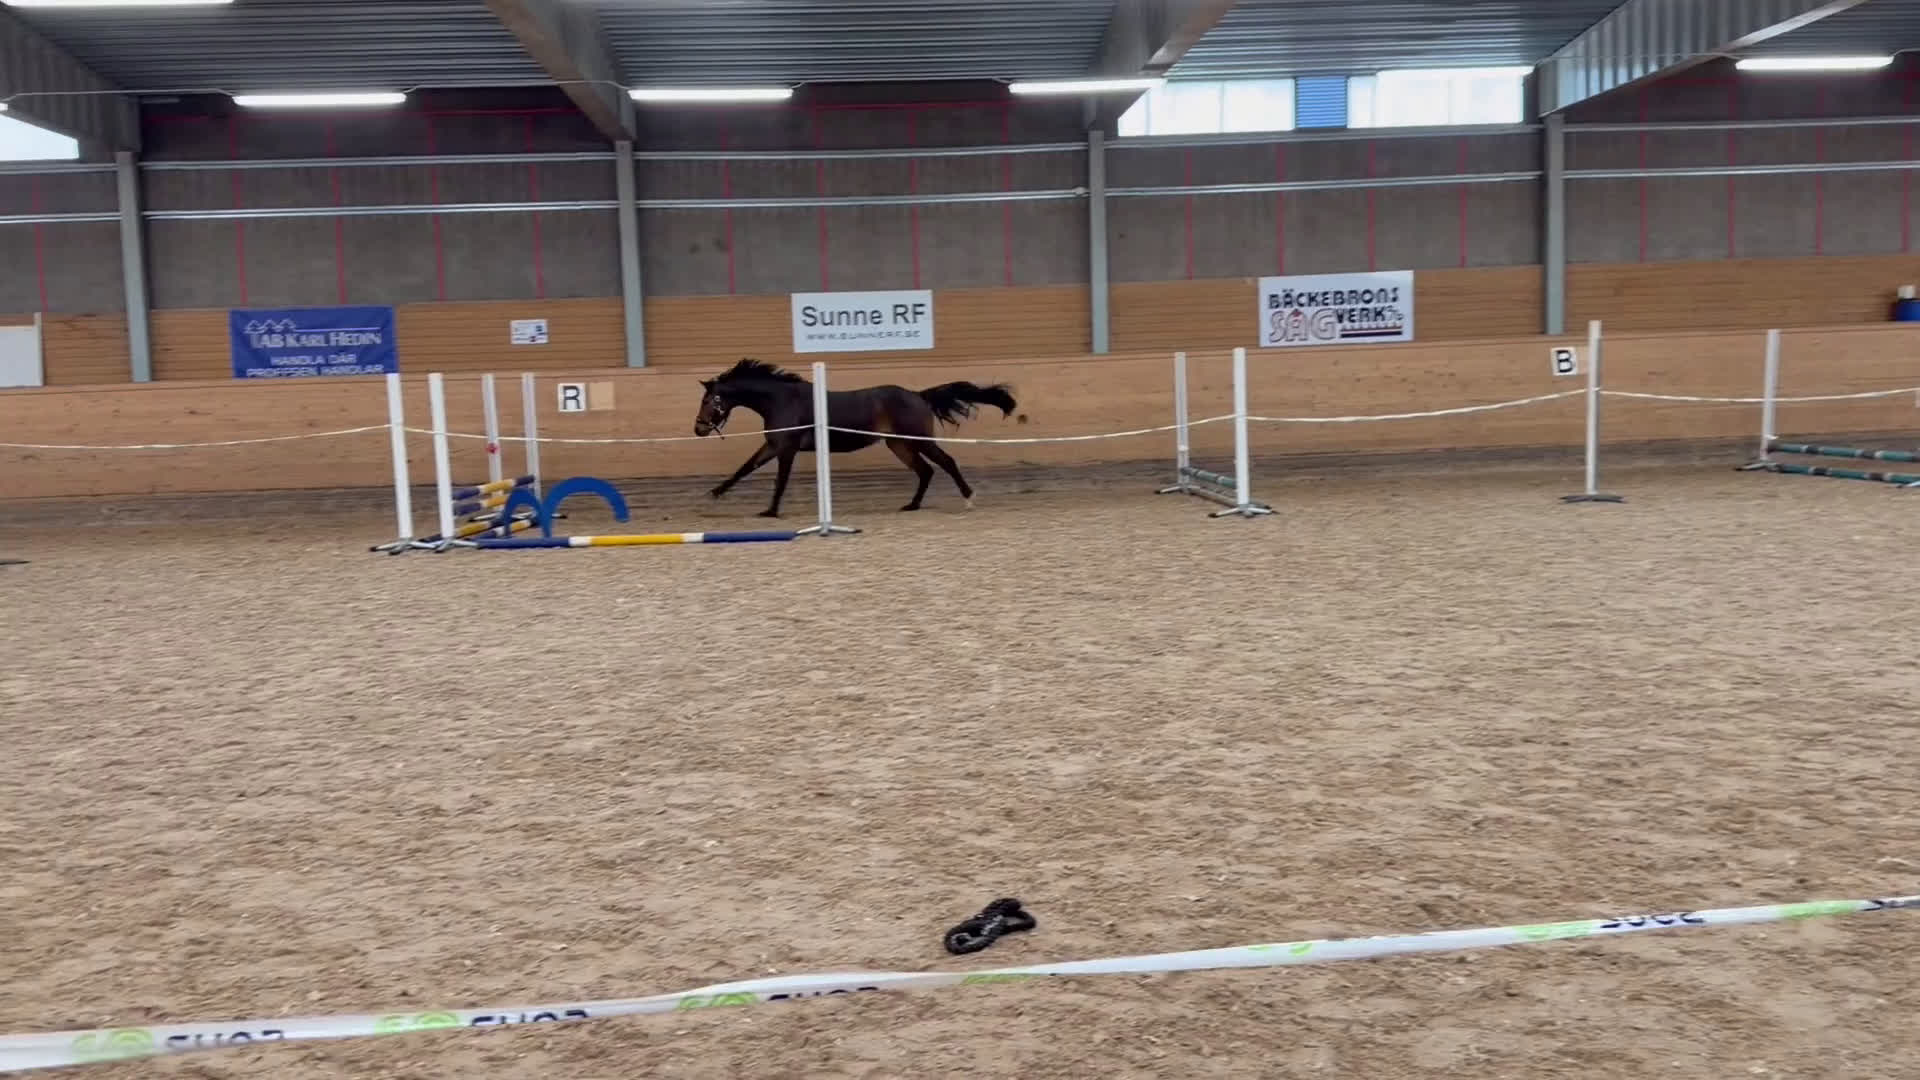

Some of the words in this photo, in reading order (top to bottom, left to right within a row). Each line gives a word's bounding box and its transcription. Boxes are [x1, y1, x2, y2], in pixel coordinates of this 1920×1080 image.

[802, 306, 883, 327] Sunne
[893, 303, 926, 324] RF
[1556, 350, 1573, 373] B
[563, 385, 581, 410] R
